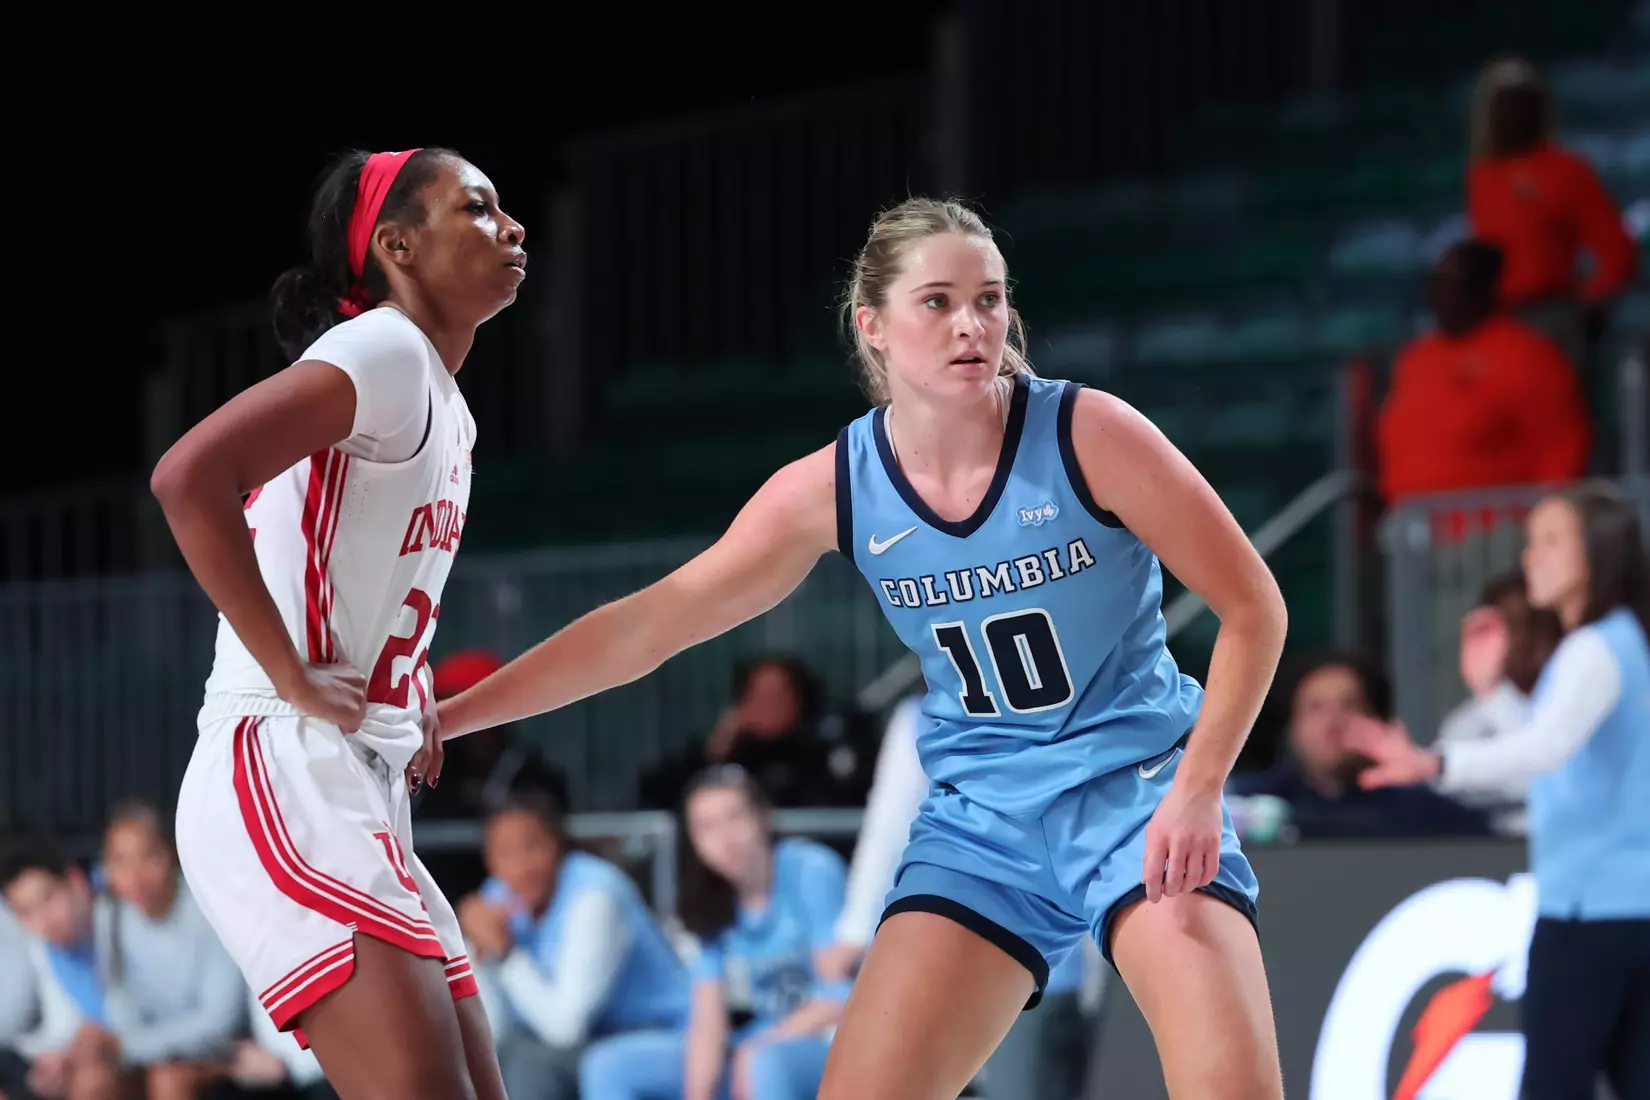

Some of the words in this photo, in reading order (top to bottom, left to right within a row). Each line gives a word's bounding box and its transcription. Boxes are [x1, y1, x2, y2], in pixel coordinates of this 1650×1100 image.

[399, 499, 467, 557] INDIA
[1020, 508, 1042, 522] Ivy
[880, 537, 1096, 608] COLUMBIA
[931, 608, 1075, 717] 10
